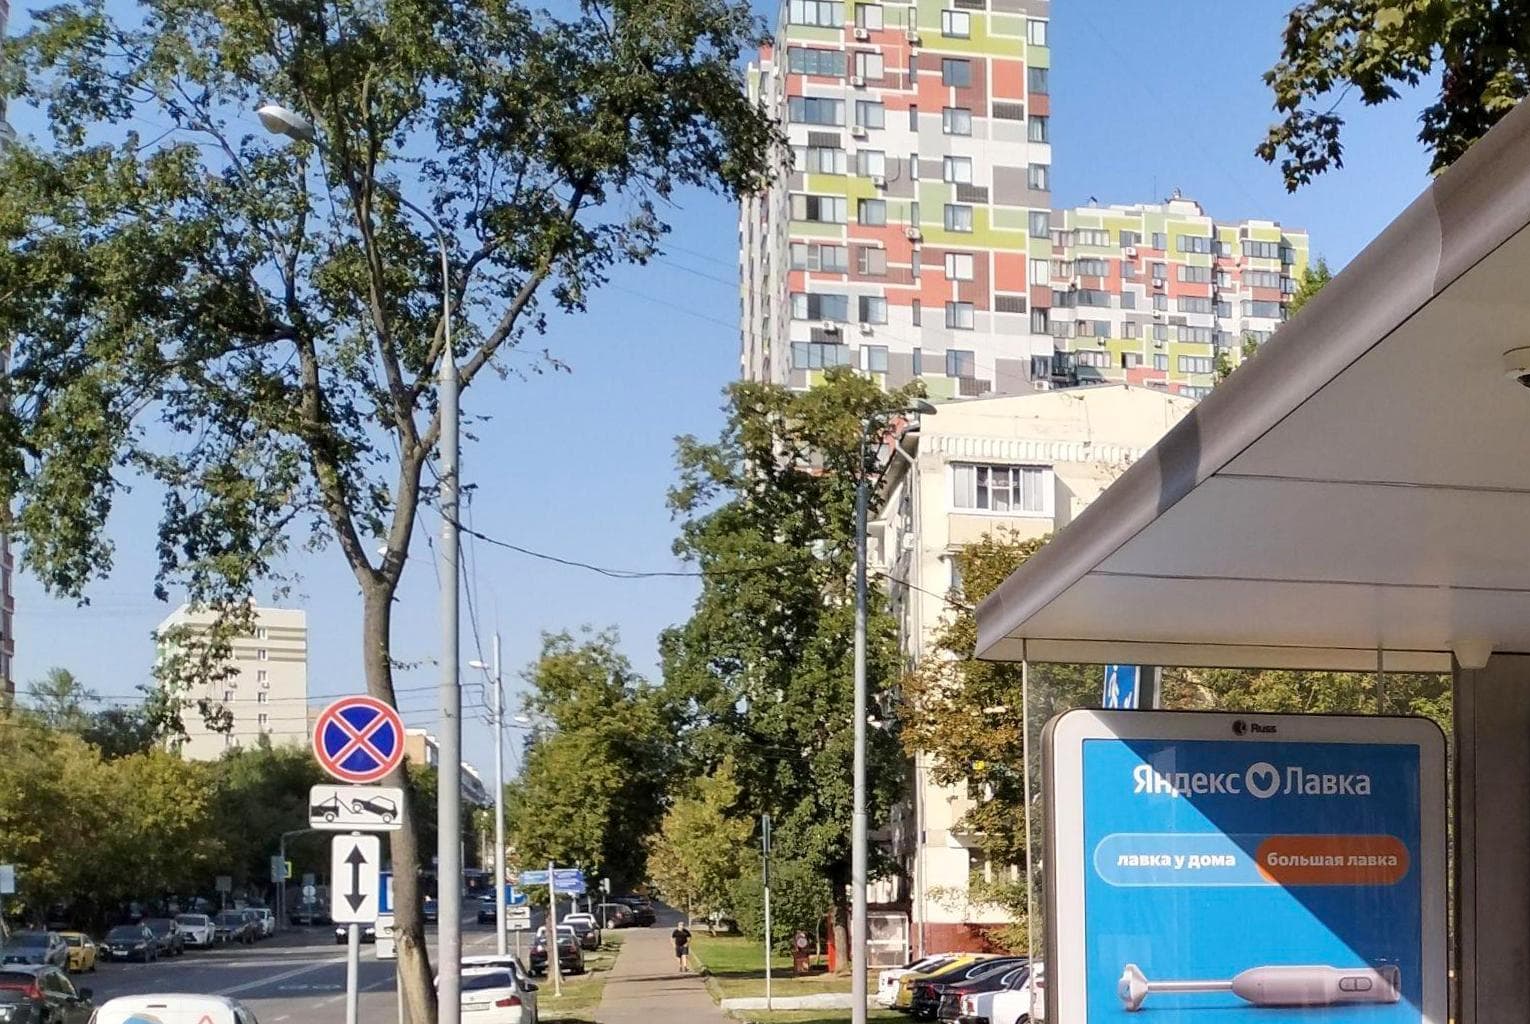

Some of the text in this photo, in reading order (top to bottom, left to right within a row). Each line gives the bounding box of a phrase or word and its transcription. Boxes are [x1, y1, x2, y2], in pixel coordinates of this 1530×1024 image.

[1251, 723, 1277, 733] Russ
[1133, 763, 1371, 799] Яндекс Лавка
[1116, 854, 1237, 870] лавка у дома
[1267, 852, 1397, 867] большая лавка
